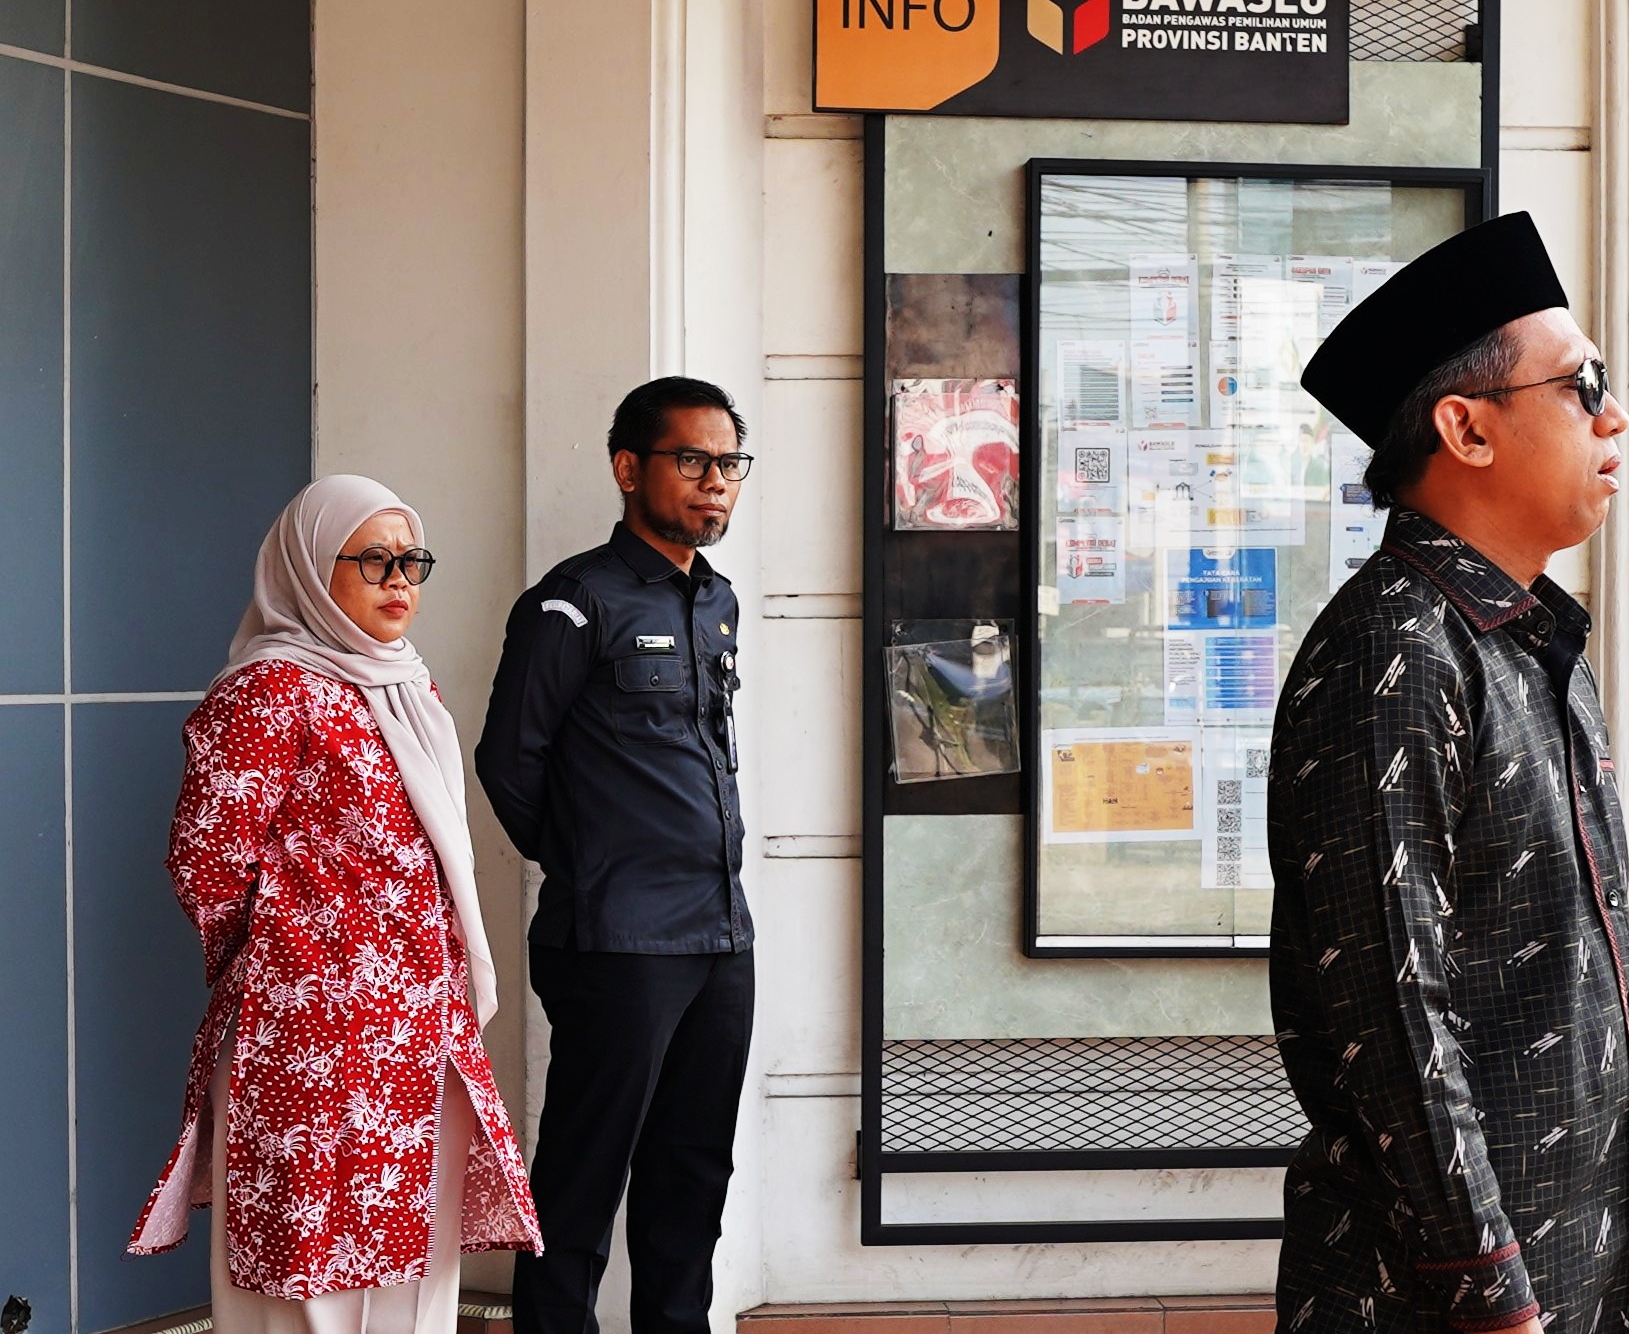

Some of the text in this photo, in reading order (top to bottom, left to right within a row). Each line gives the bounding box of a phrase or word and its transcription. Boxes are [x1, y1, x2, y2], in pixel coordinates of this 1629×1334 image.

[1121, 13, 1327, 30] BADAN PENGAWAS PEMILIHAN UMUM
[1121, 28, 1328, 53] PROVINSI BANTEN
